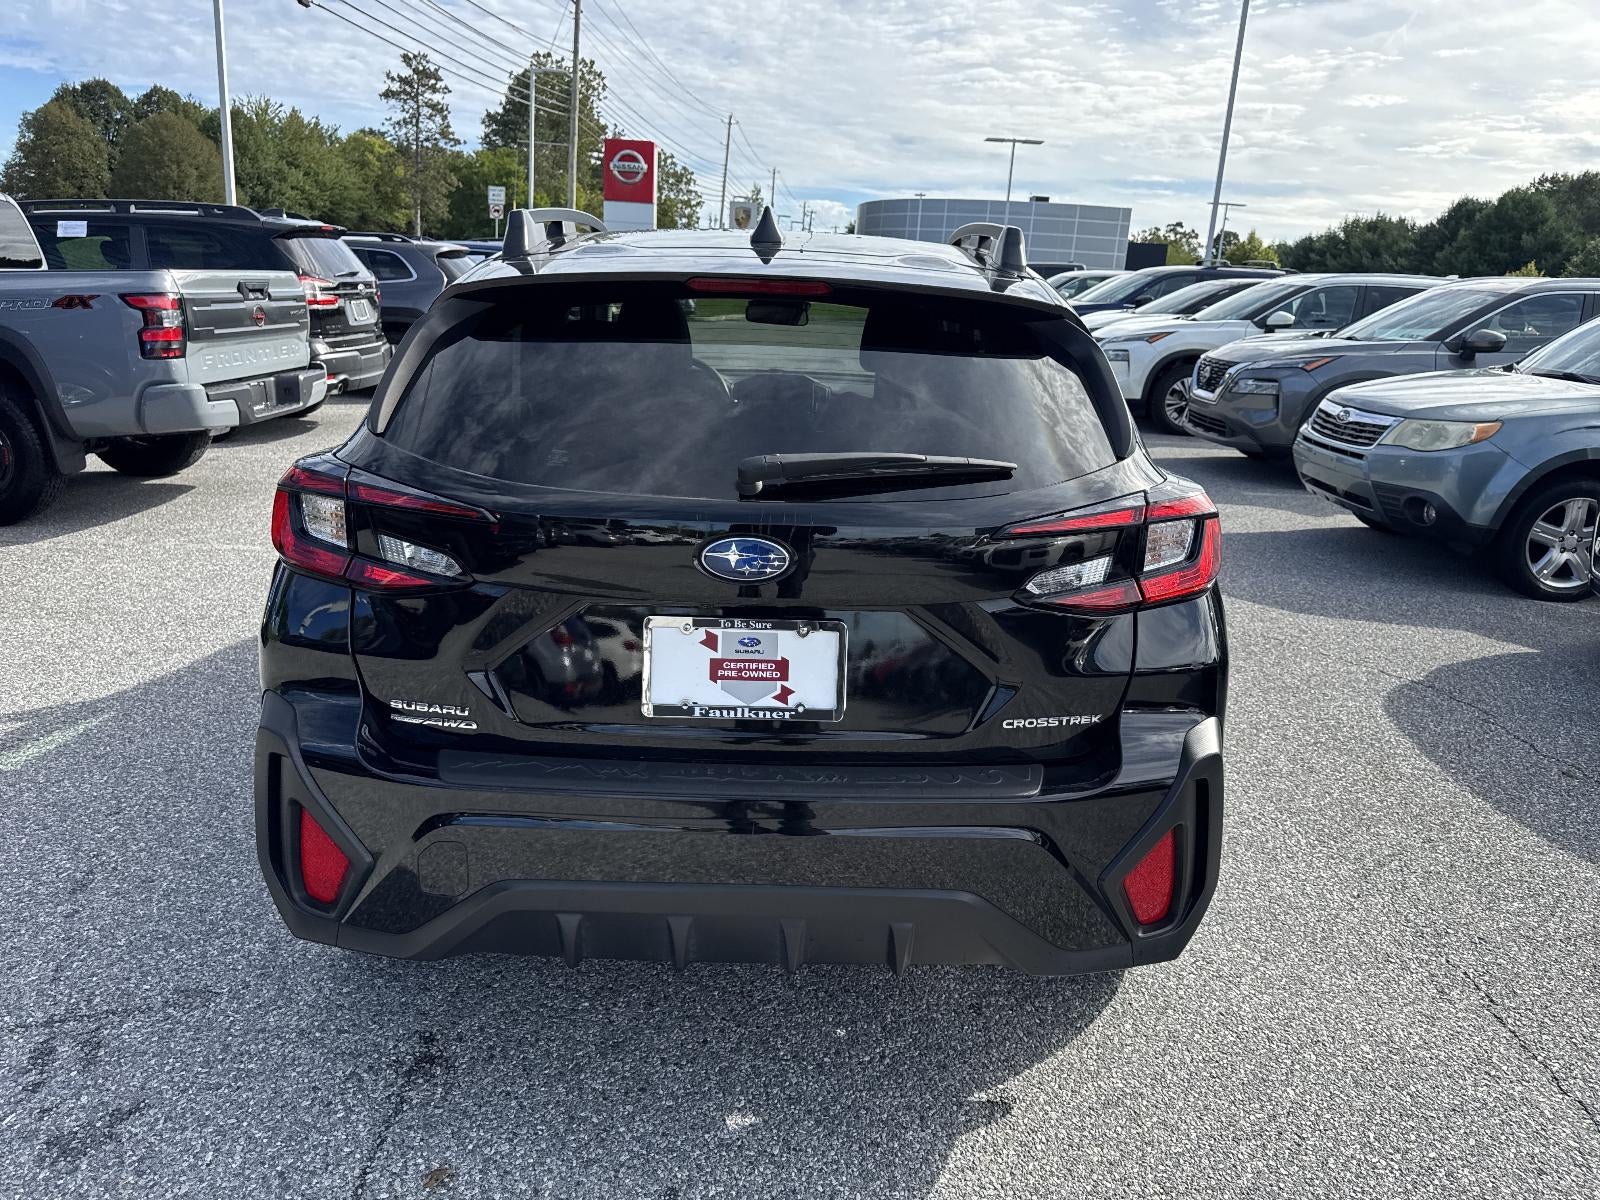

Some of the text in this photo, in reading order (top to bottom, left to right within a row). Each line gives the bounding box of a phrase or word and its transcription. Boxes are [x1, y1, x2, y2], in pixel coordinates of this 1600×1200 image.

[612, 163, 644, 171] NISSAN
[202, 344, 301, 370] FRONTIER
[719, 619, 772, 629] To Be Sure
[722, 662, 776, 671] CERTIFIED
[717, 670, 781, 679] PRE-OWNED
[389, 699, 470, 716] SUBARU
[693, 706, 796, 719] Faulkner
[423, 717, 478, 730] AWD
[1002, 714, 1103, 729] CROSSTREK
